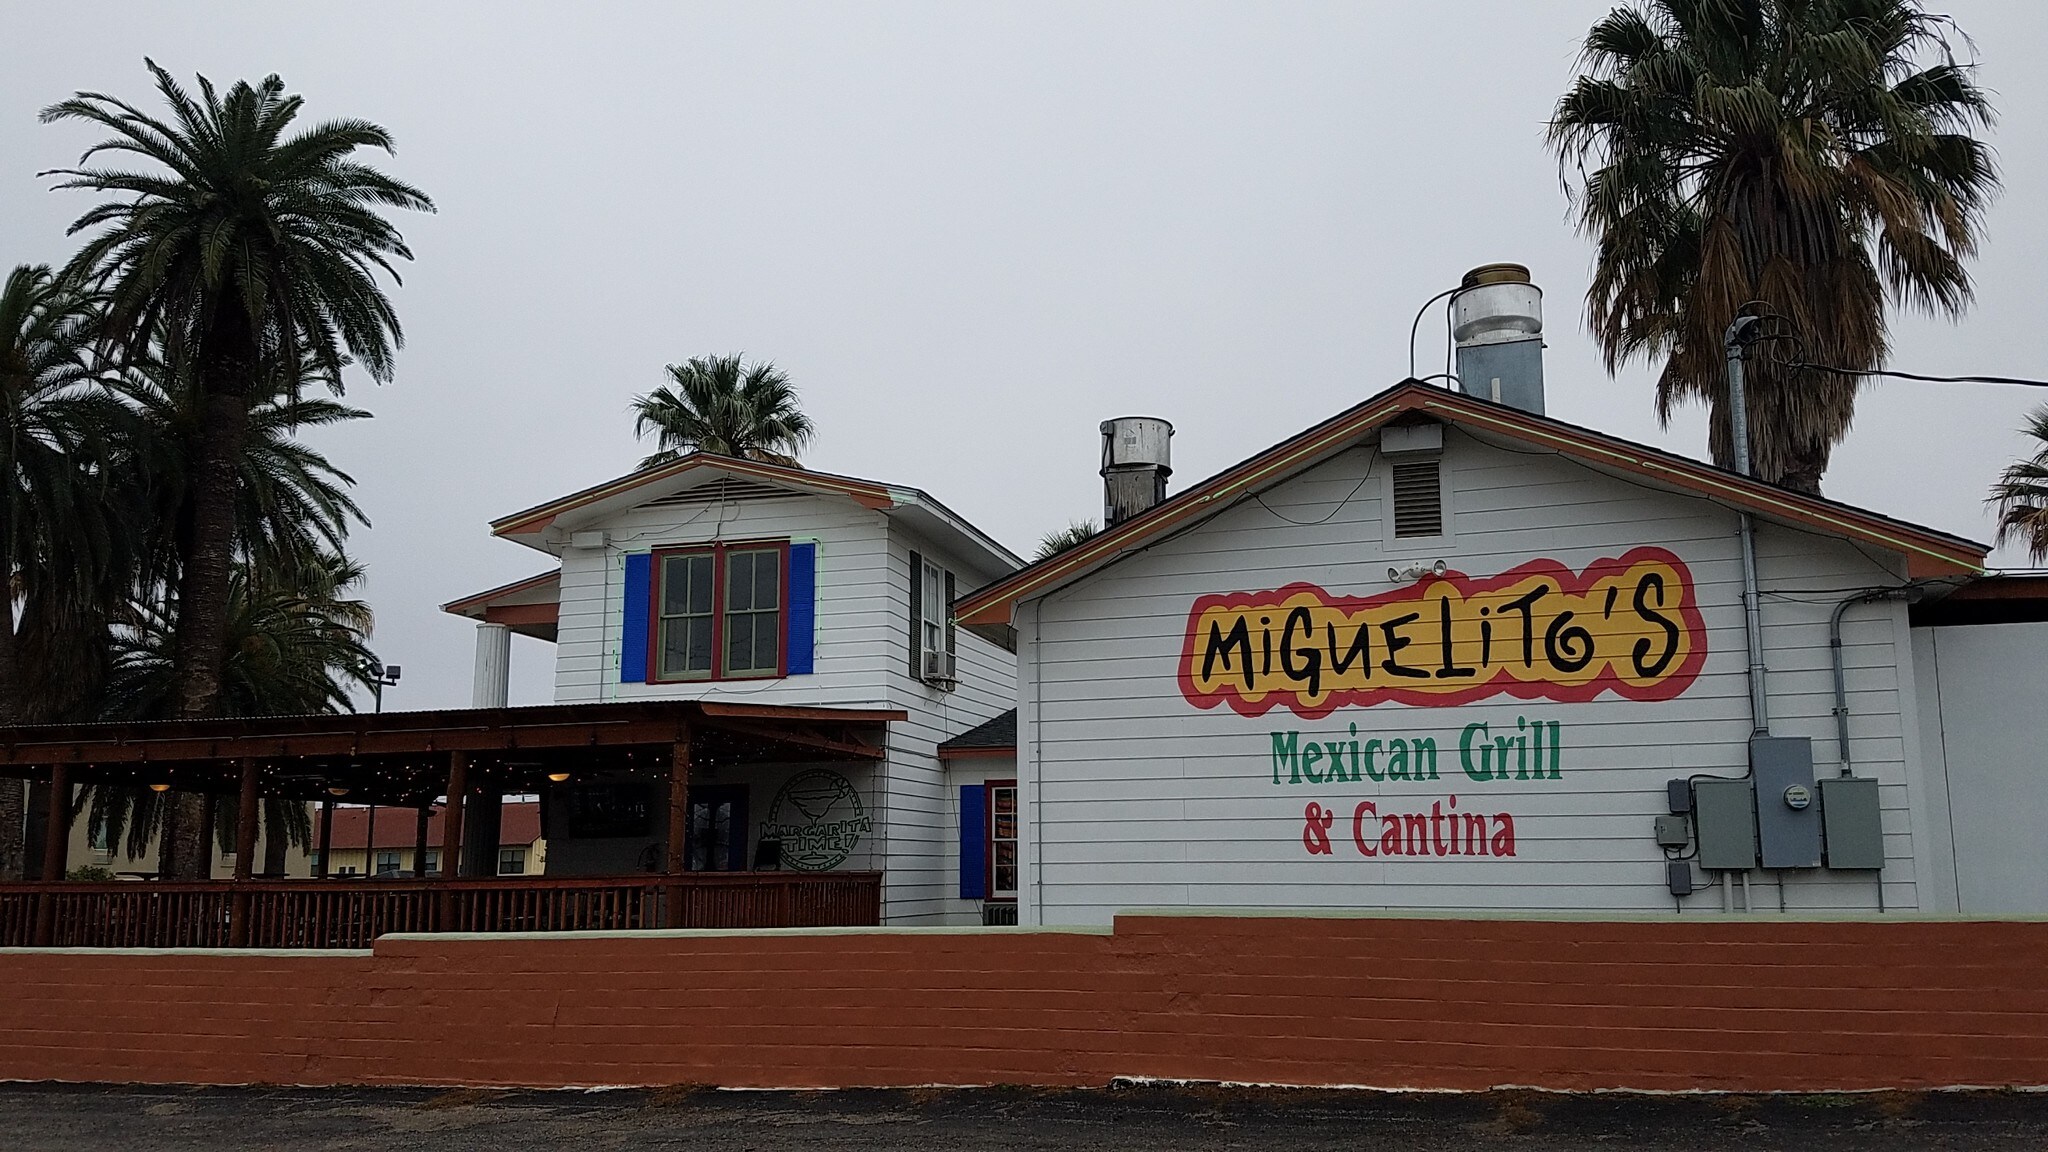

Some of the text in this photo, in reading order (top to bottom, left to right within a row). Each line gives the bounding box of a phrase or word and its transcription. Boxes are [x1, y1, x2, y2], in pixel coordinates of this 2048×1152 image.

[1270, 715, 1563, 784] Mexican Grill
[760, 816, 872, 839] MARGARITA
[781, 833, 857, 854] TIME!
[1303, 794, 1516, 857] & Cantina
